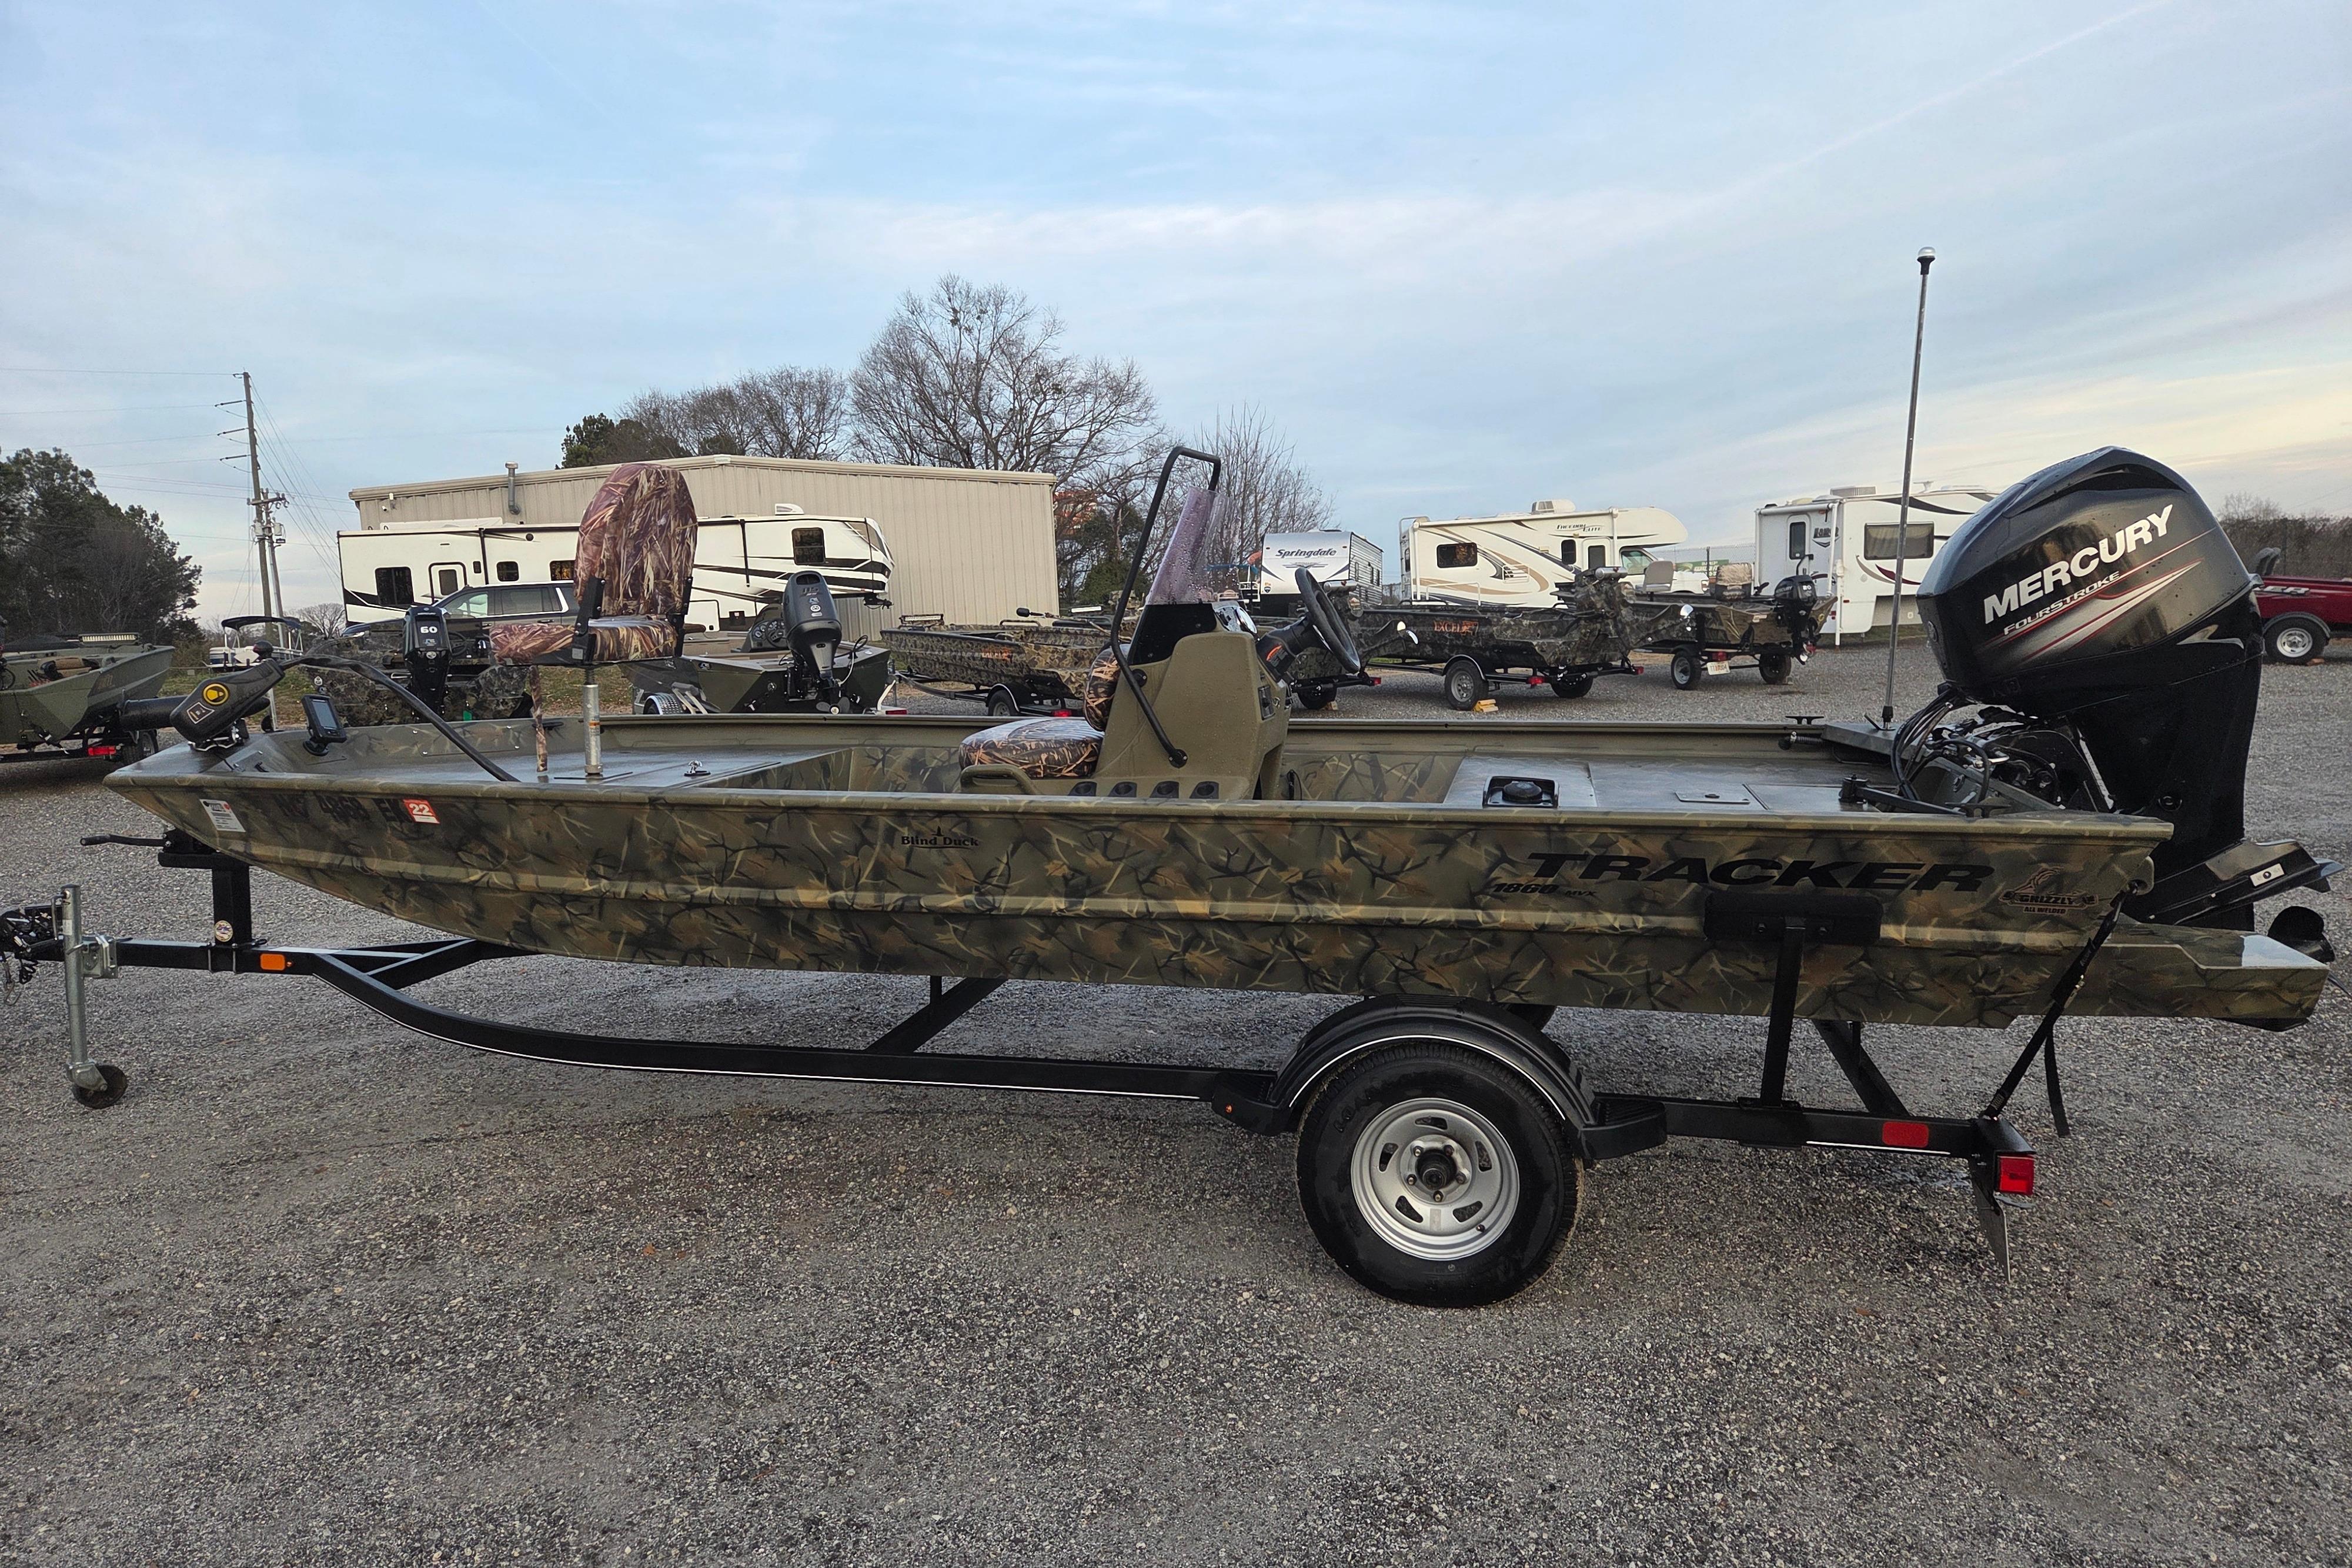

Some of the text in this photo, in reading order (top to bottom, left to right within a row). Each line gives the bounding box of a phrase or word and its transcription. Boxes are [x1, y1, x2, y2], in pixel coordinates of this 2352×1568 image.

[1275, 547, 1337, 559] Springdale
[1984, 504, 2173, 624] MERCURY
[2003, 570, 2121, 636] FOURSTROKE
[420, 626, 438, 634] 60
[409, 803, 433, 815] 22
[901, 836, 979, 846] Blind Duck
[1528, 852, 1996, 892] TRACKER
[1492, 882, 1560, 894] 1860
[2019, 894, 2074, 905] GRIZZLY
